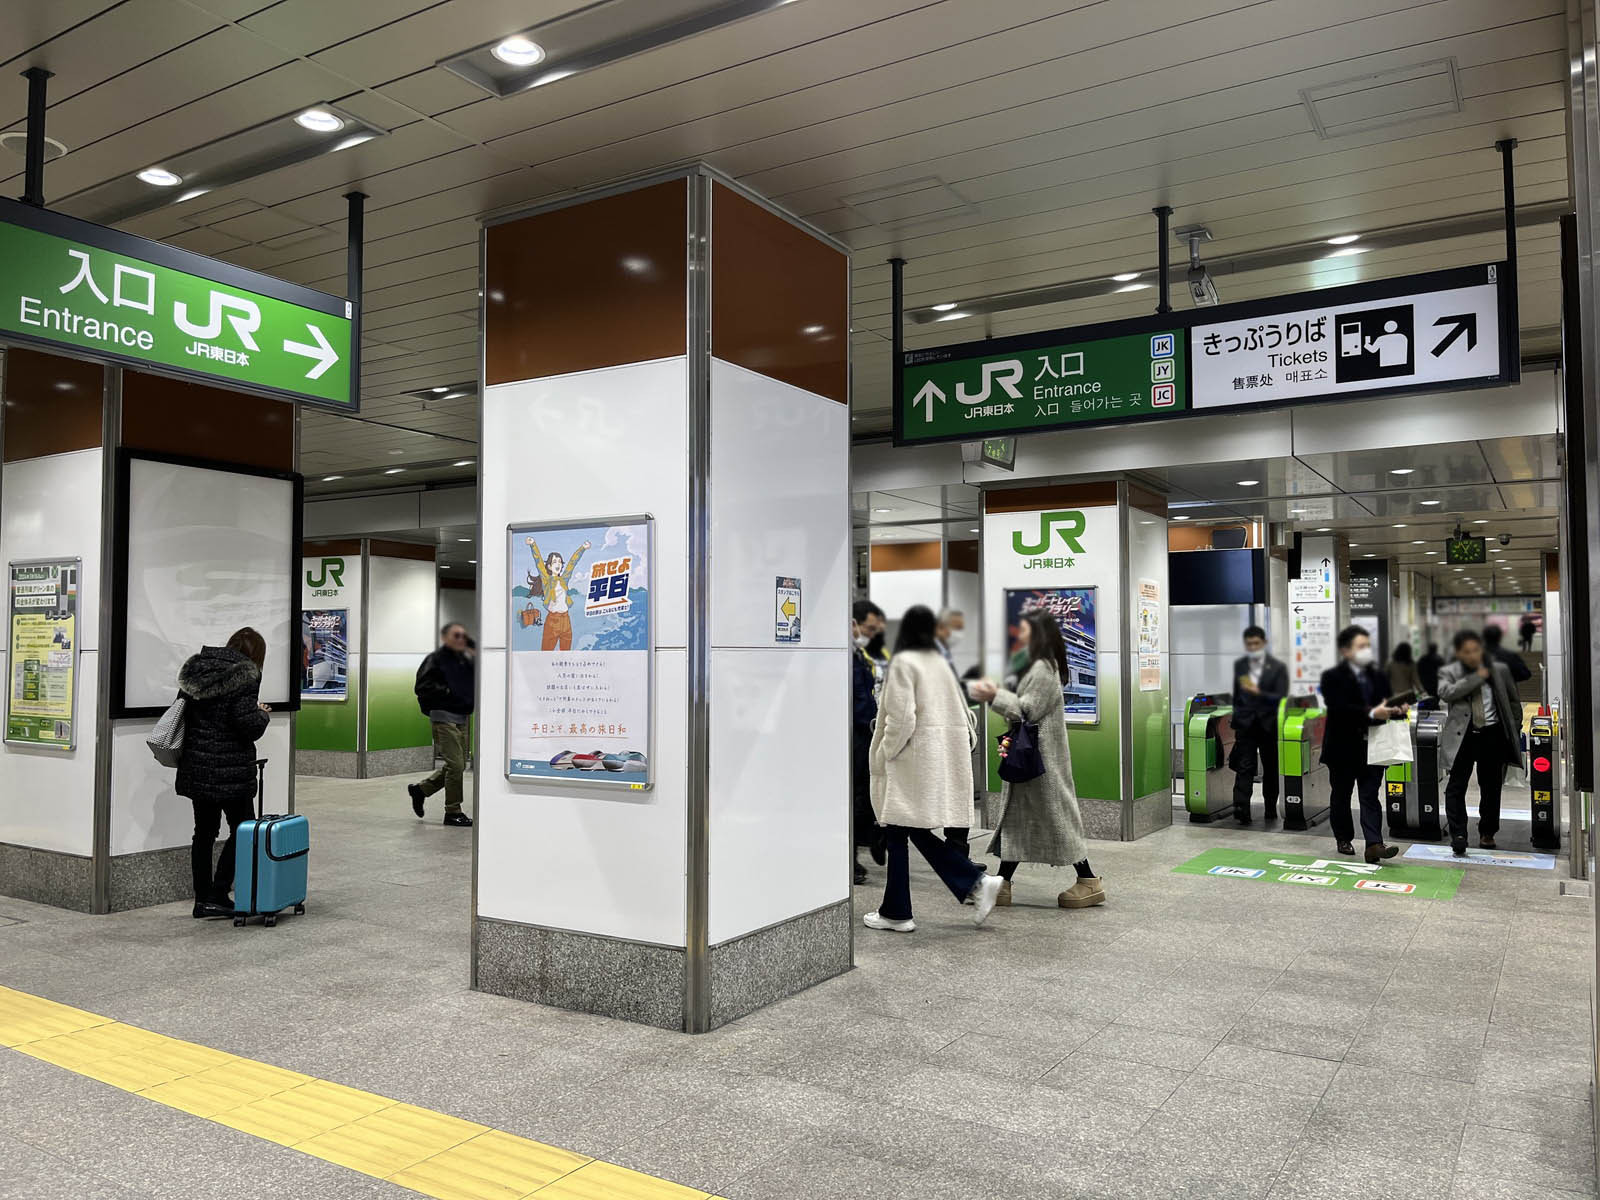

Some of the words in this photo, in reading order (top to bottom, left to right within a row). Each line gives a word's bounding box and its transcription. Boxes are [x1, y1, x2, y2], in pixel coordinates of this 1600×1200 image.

[59, 249, 156, 316] 入口
[20, 296, 155, 350] Entrance
[174, 290, 262, 352] JR
[1156, 340, 1169, 352] JK
[1203, 316, 1327, 355] きっぷうりば
[185, 341, 250, 367] JR東日本
[1034, 351, 1085, 382] 入口
[1267, 350, 1328, 368] Tickets
[956, 359, 1024, 405] JR
[1156, 365, 1170, 377] JY
[1232, 374, 1273, 390] 售票处
[1285, 367, 1328, 384] 매표소
[1033, 381, 1102, 401] Entrance
[1157, 389, 1170, 401] JC
[964, 402, 1015, 420] JR東日本
[1034, 403, 1060, 418] 入口
[1070, 396, 1123, 414] 들어가는
[1129, 393, 1142, 408] 곳
[1013, 511, 1086, 555] JR
[308, 558, 344, 587] JR
[1024, 557, 1075, 569] JR東日本
[588, 574, 629, 602] 平日
